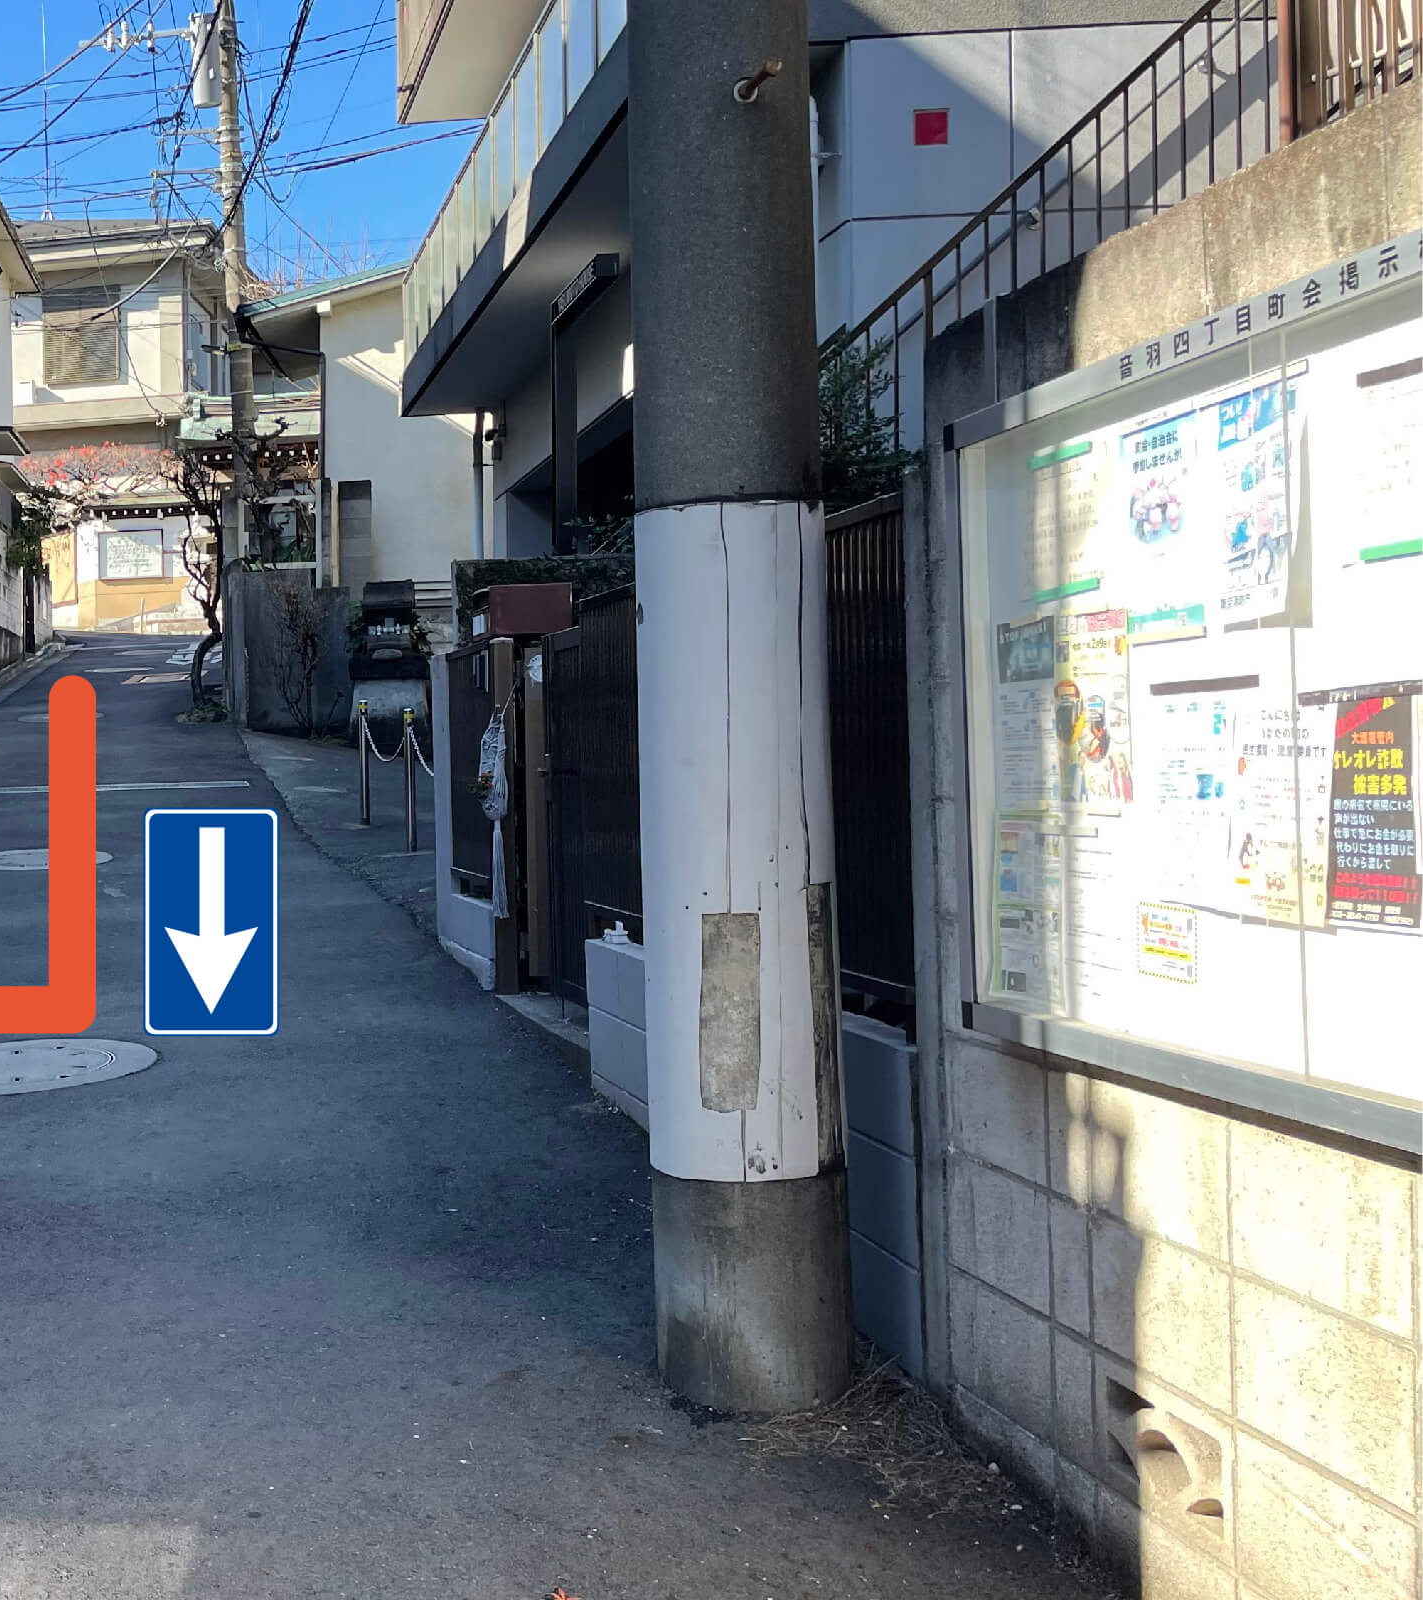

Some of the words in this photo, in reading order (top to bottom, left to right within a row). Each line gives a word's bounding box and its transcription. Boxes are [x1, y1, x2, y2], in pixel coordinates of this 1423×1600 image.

[1118, 239, 1422, 380] 音羽四丁目町会掲示
[1333, 748, 1404, 770] オレオレ詐欺
[1353, 774, 1407, 796] 被害多発
[1334, 813, 1375, 826] 声が出ない
[1333, 827, 1415, 842] 仕事で急にお金が必要
[1336, 841, 1415, 856] 代わりにお金を取りに
